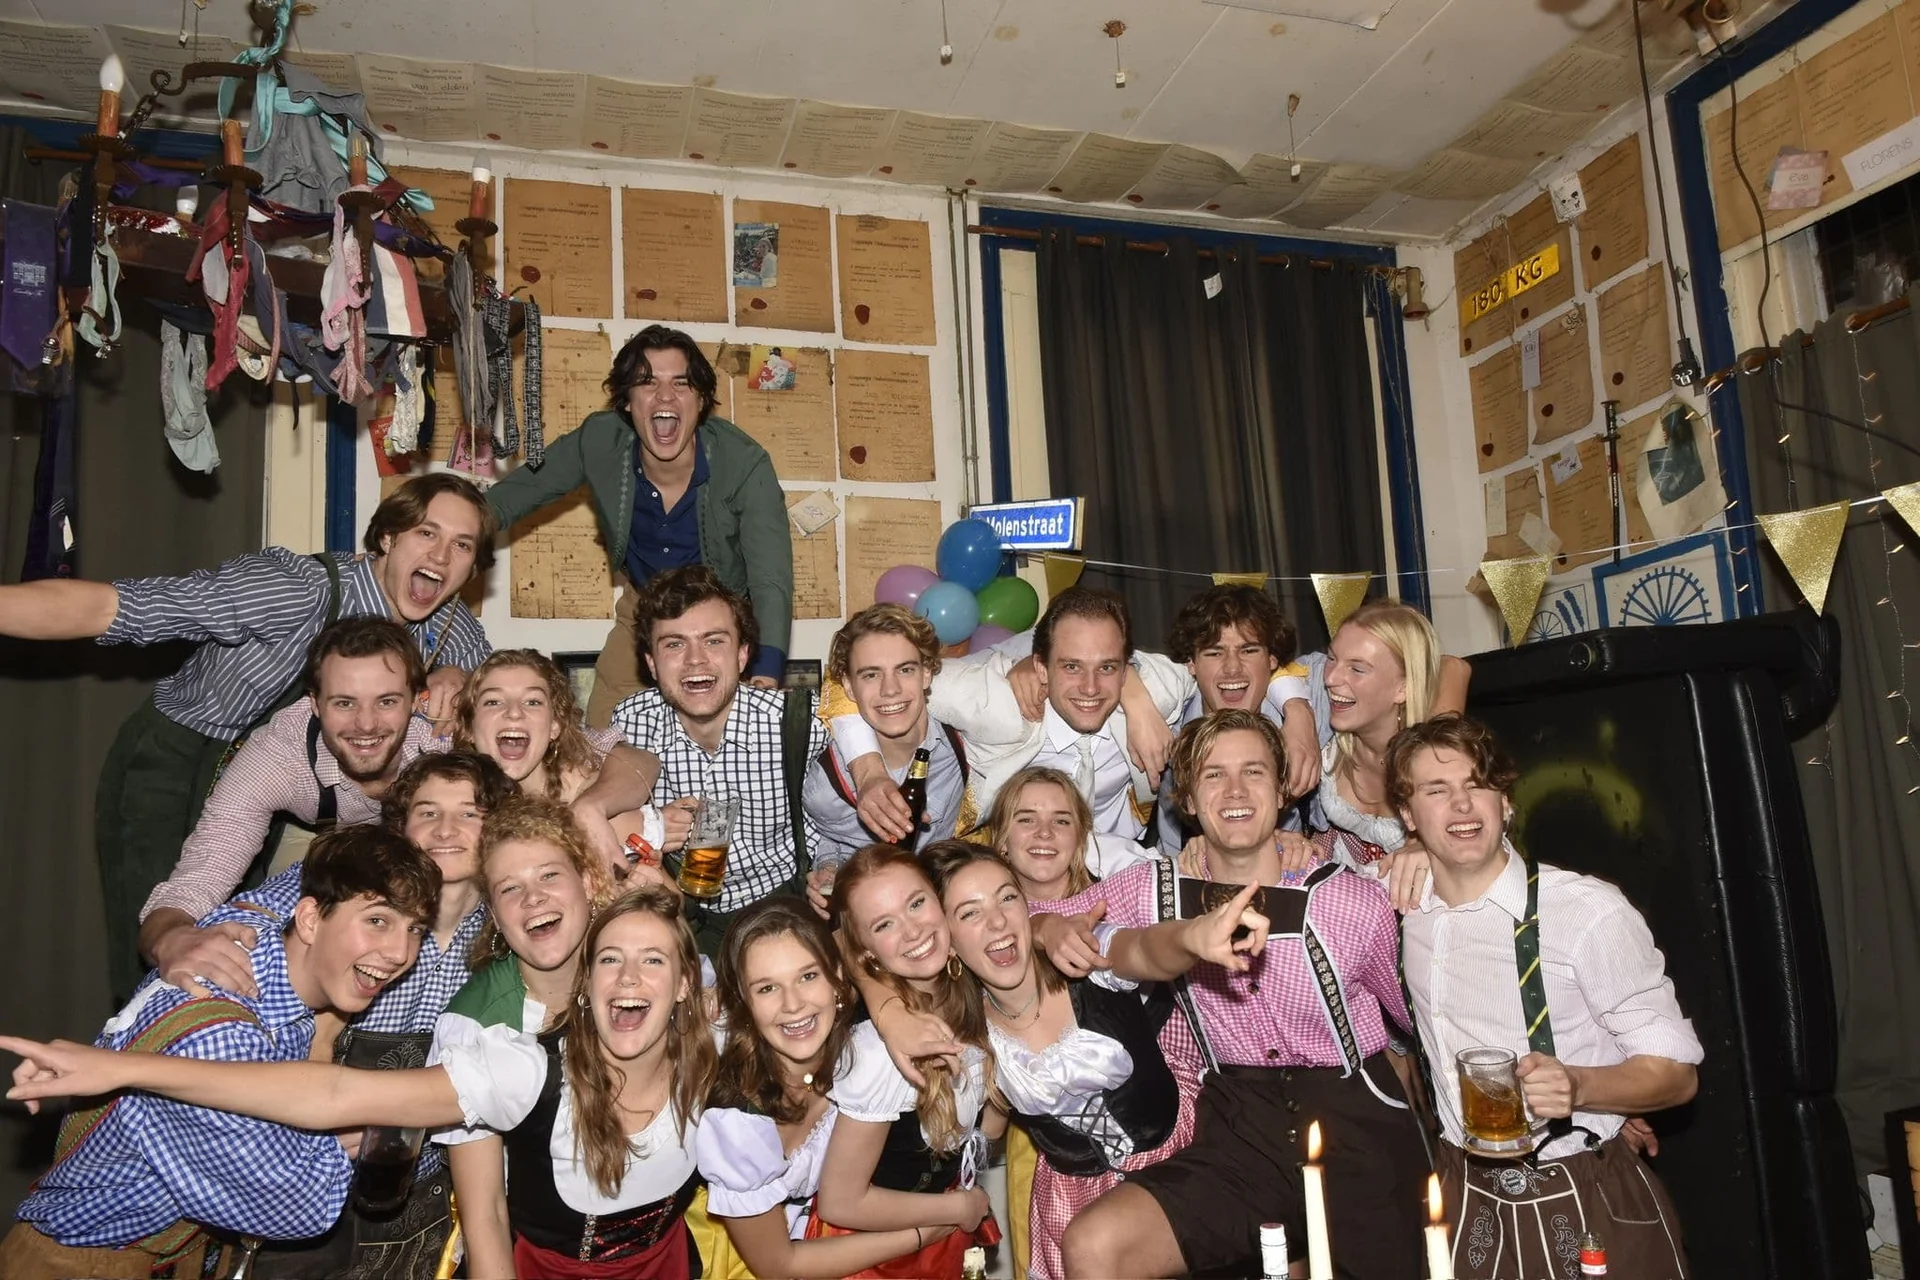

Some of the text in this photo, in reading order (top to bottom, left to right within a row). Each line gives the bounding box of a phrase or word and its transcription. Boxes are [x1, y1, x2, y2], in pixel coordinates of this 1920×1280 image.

[1859, 136, 1914, 171] FLORENS
[1472, 255, 1544, 318] 180 KG
